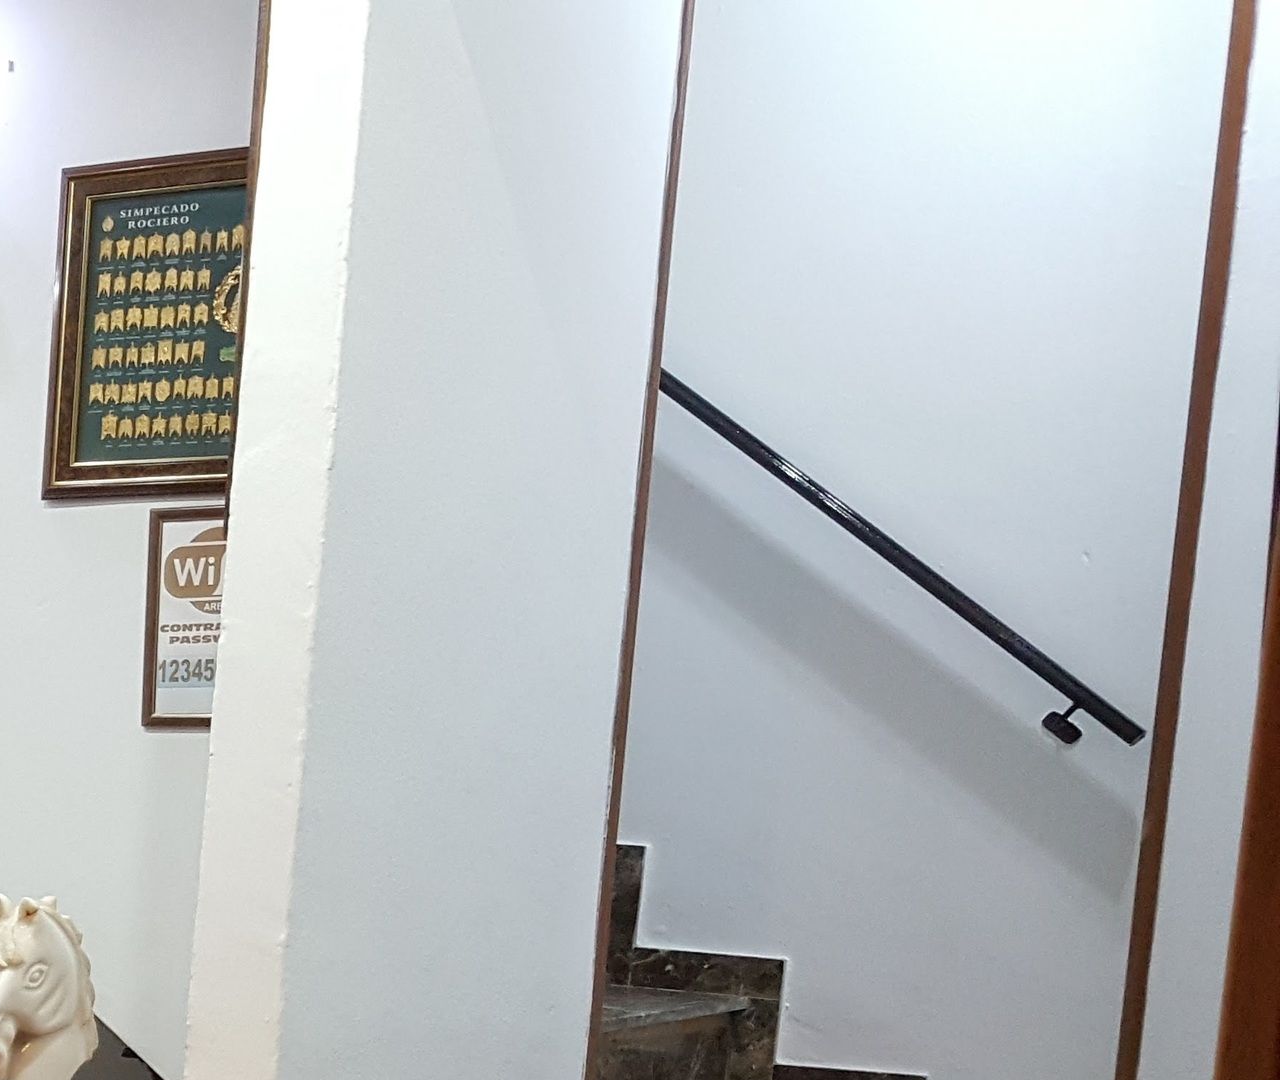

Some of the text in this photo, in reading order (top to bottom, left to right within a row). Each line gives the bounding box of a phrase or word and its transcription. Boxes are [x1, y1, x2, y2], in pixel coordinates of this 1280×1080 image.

[120, 202, 199, 218] SIMPECADO
[128, 216, 189, 229] ROCIERO
[174, 557, 215, 586] Wi
